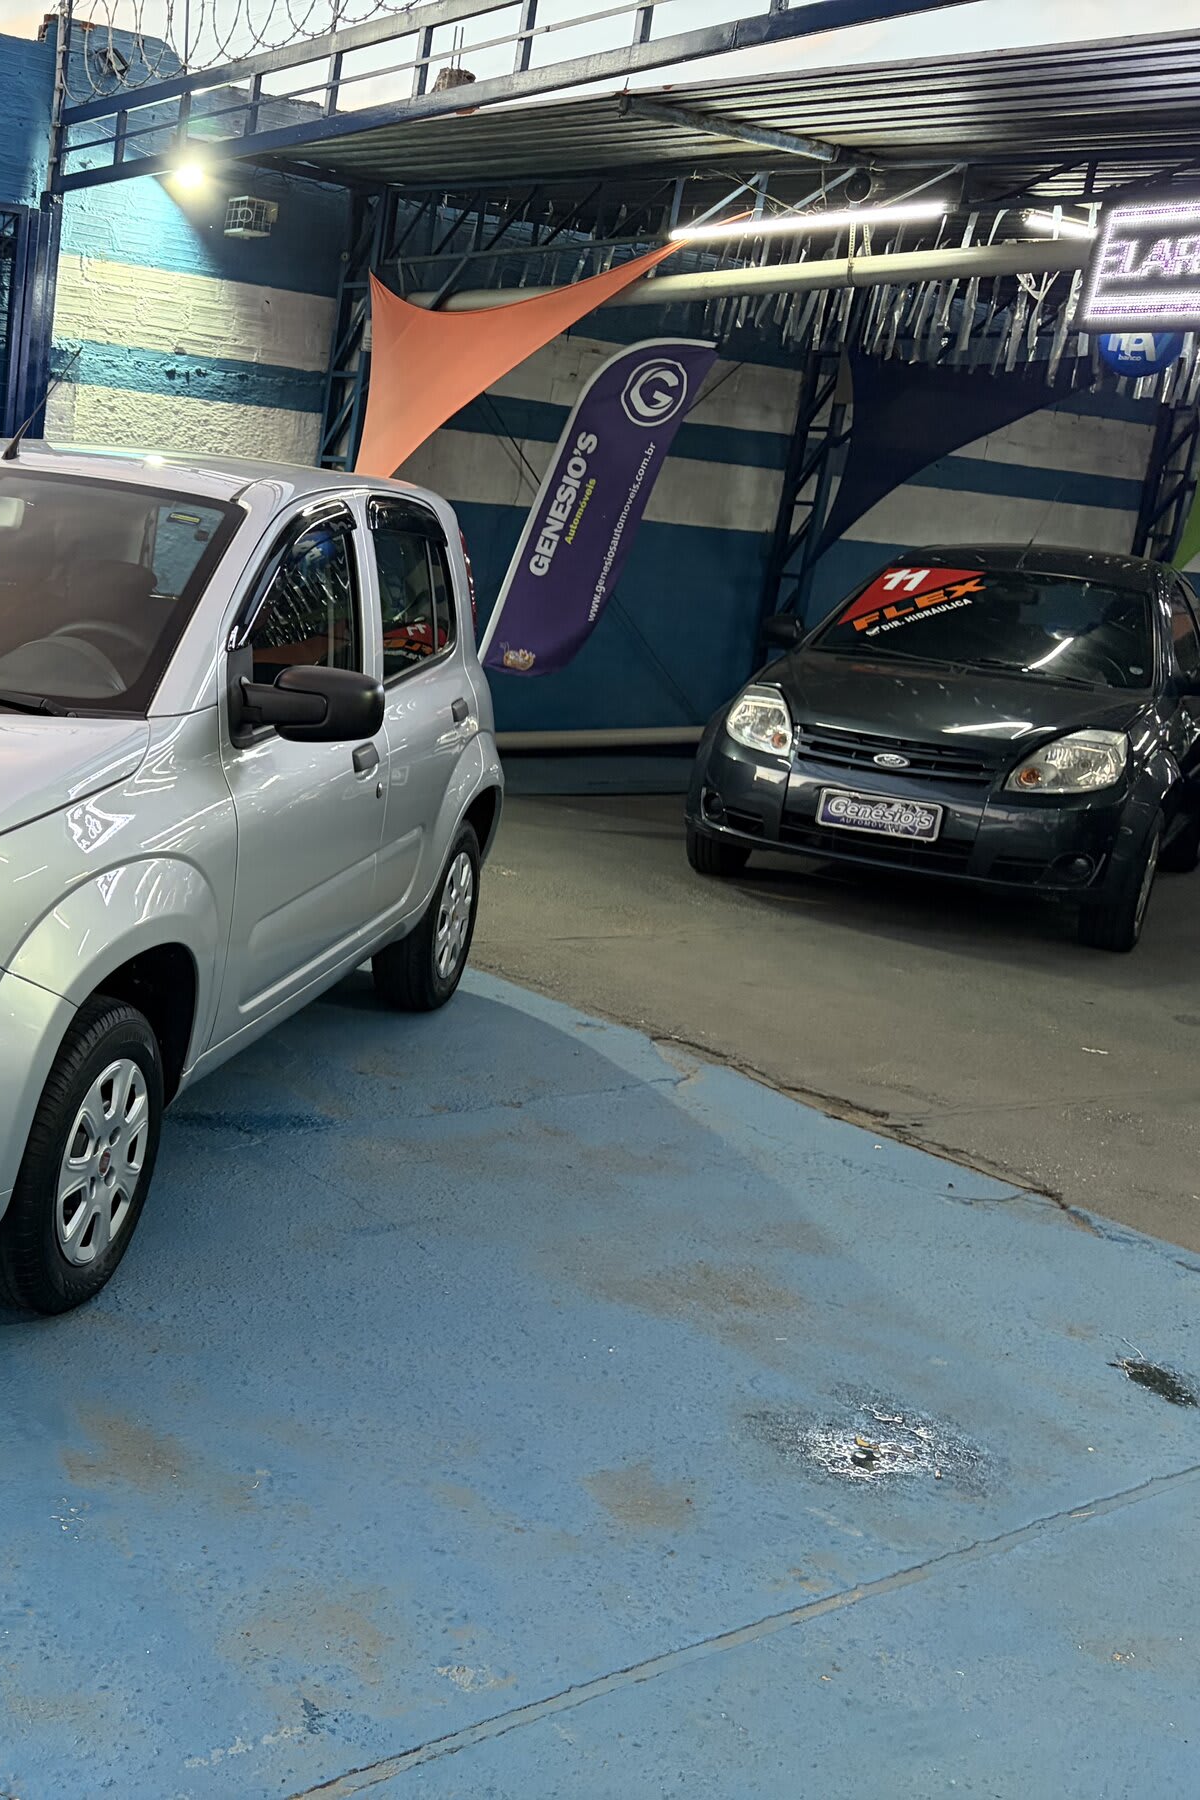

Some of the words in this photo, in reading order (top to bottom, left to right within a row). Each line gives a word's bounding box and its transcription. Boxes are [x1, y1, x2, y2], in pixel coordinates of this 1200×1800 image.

[564, 478, 597, 545] Automóveis
[587, 441, 656, 622] www.genesiosautomoveis.com.br
[883, 568, 931, 592] 11
[853, 578, 987, 632] FLEX
[881, 618, 906, 632] DIR.
[904, 598, 973, 623] HIDRAULICA
[828, 797, 934, 829] Genésio's
